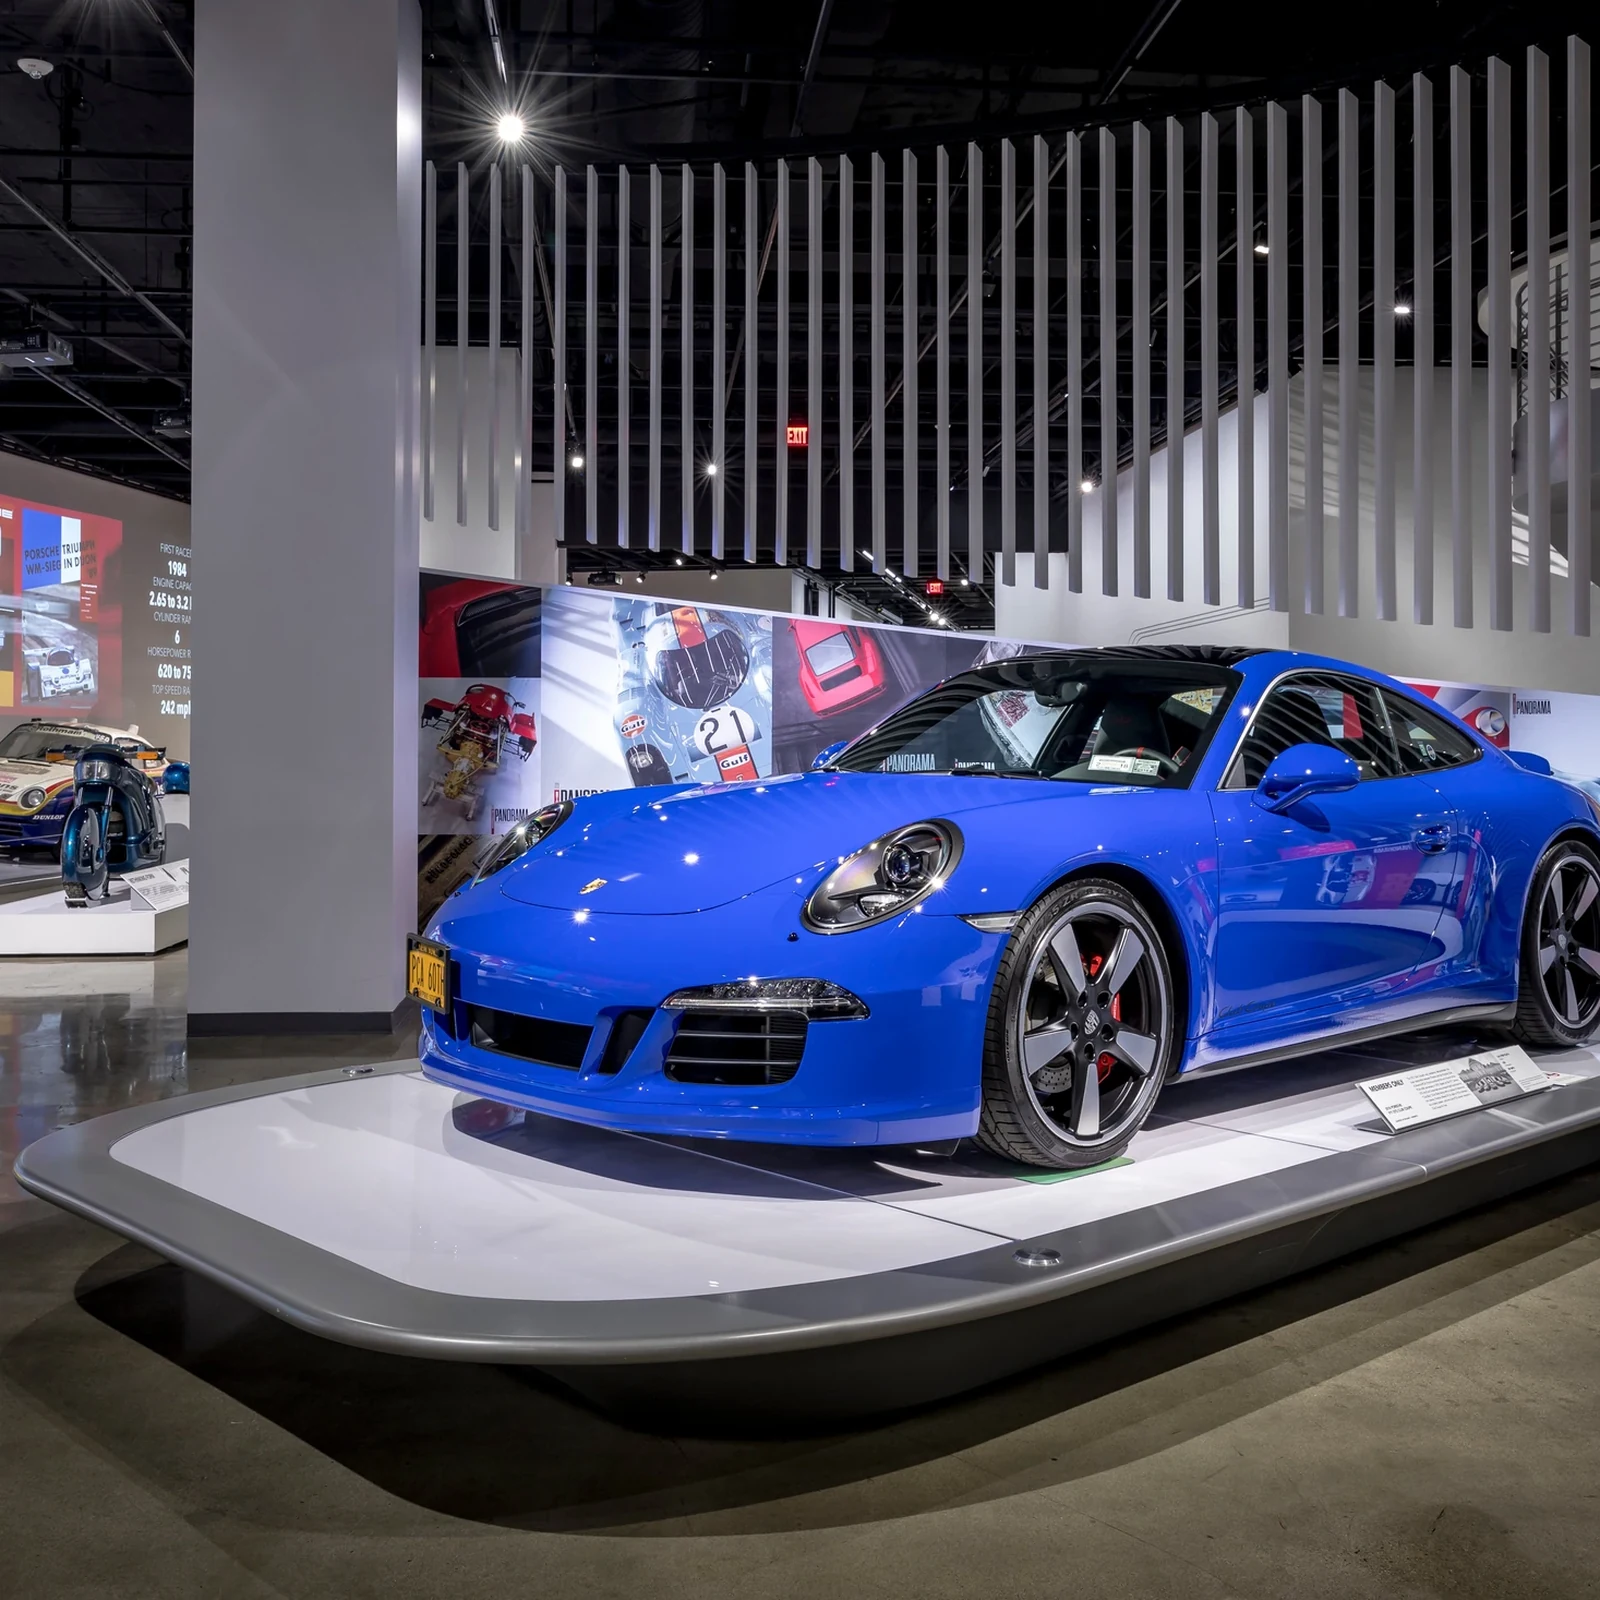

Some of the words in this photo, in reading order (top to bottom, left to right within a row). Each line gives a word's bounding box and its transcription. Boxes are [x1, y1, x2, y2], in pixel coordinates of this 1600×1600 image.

[787, 427, 807, 444] EXIT
[24, 545, 60, 561] PORSCHE
[160, 542, 175, 555] FIRST
[25, 559, 61, 575] WM-SIEG
[64, 558, 73, 569] IN
[168, 560, 187, 577] 1984
[153, 576, 174, 589] ENGINE
[149, 591, 167, 607] 2.65
[168, 594, 176, 609] to
[176, 595, 189, 610] 3.2
[153, 611, 181, 624] CYLINDER
[174, 629, 180, 645] 6
[147, 646, 186, 659] HORSEPOWER
[157, 663, 173, 679] 620
[173, 665, 181, 680] to
[152, 684, 165, 695] TOP
[164, 685, 182, 696] SPEED
[160, 700, 176, 715] 242
[1516, 700, 1551, 715] PANORAMA
[621, 719, 646, 734] Gulf
[700, 709, 747, 754] 21
[720, 754, 749, 769] Gulf
[887, 753, 936, 772] PANORAMA
[494, 808, 529, 822] PANORAMA
